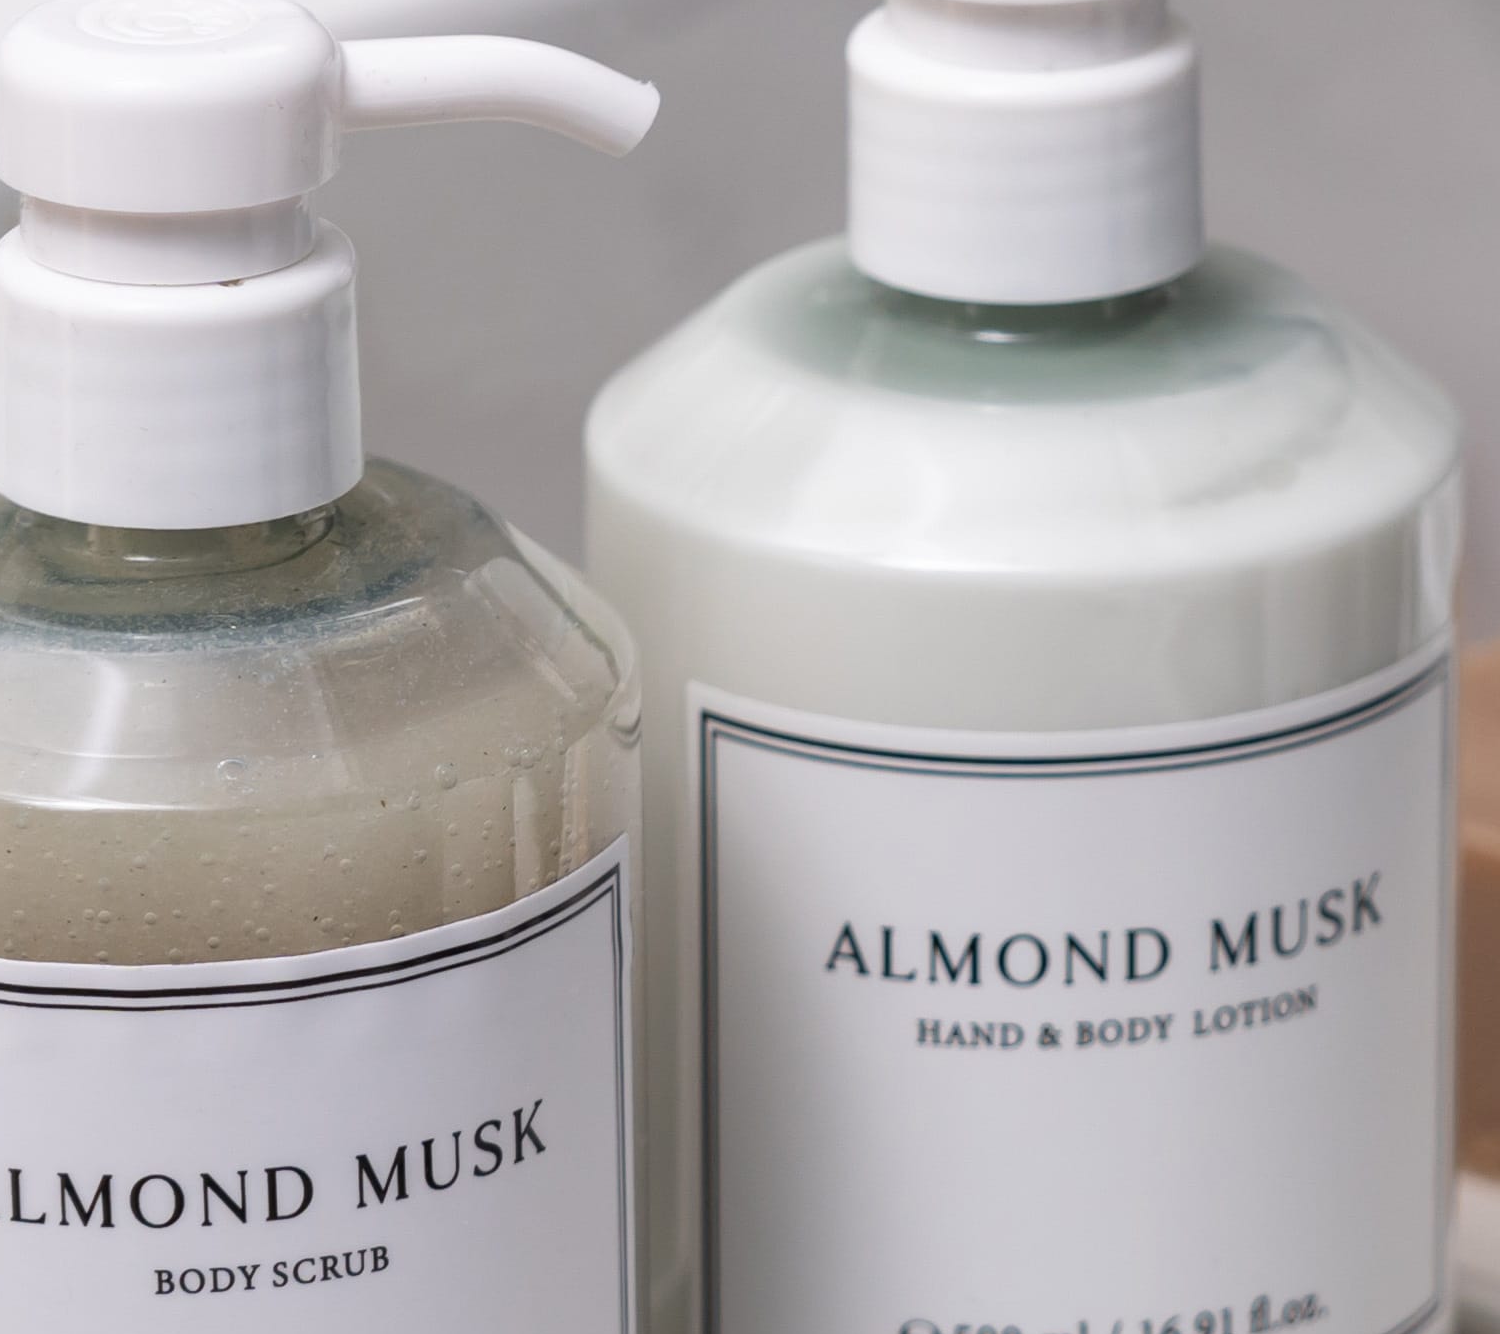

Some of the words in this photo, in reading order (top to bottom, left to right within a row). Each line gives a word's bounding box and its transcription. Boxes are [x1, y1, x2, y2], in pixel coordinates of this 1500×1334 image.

[824, 921, 1173, 989] ALMOND
[1208, 871, 1383, 974] MUSK
[915, 1017, 1025, 1051] HAND
[1037, 1021, 1062, 1050] &
[1075, 1012, 1175, 1049] BODY
[1192, 984, 1318, 1038] LOTION
[354, 1098, 547, 1210] MUSK
[153, 1263, 261, 1296] BODY
[271, 1245, 390, 1289] SCRUB
